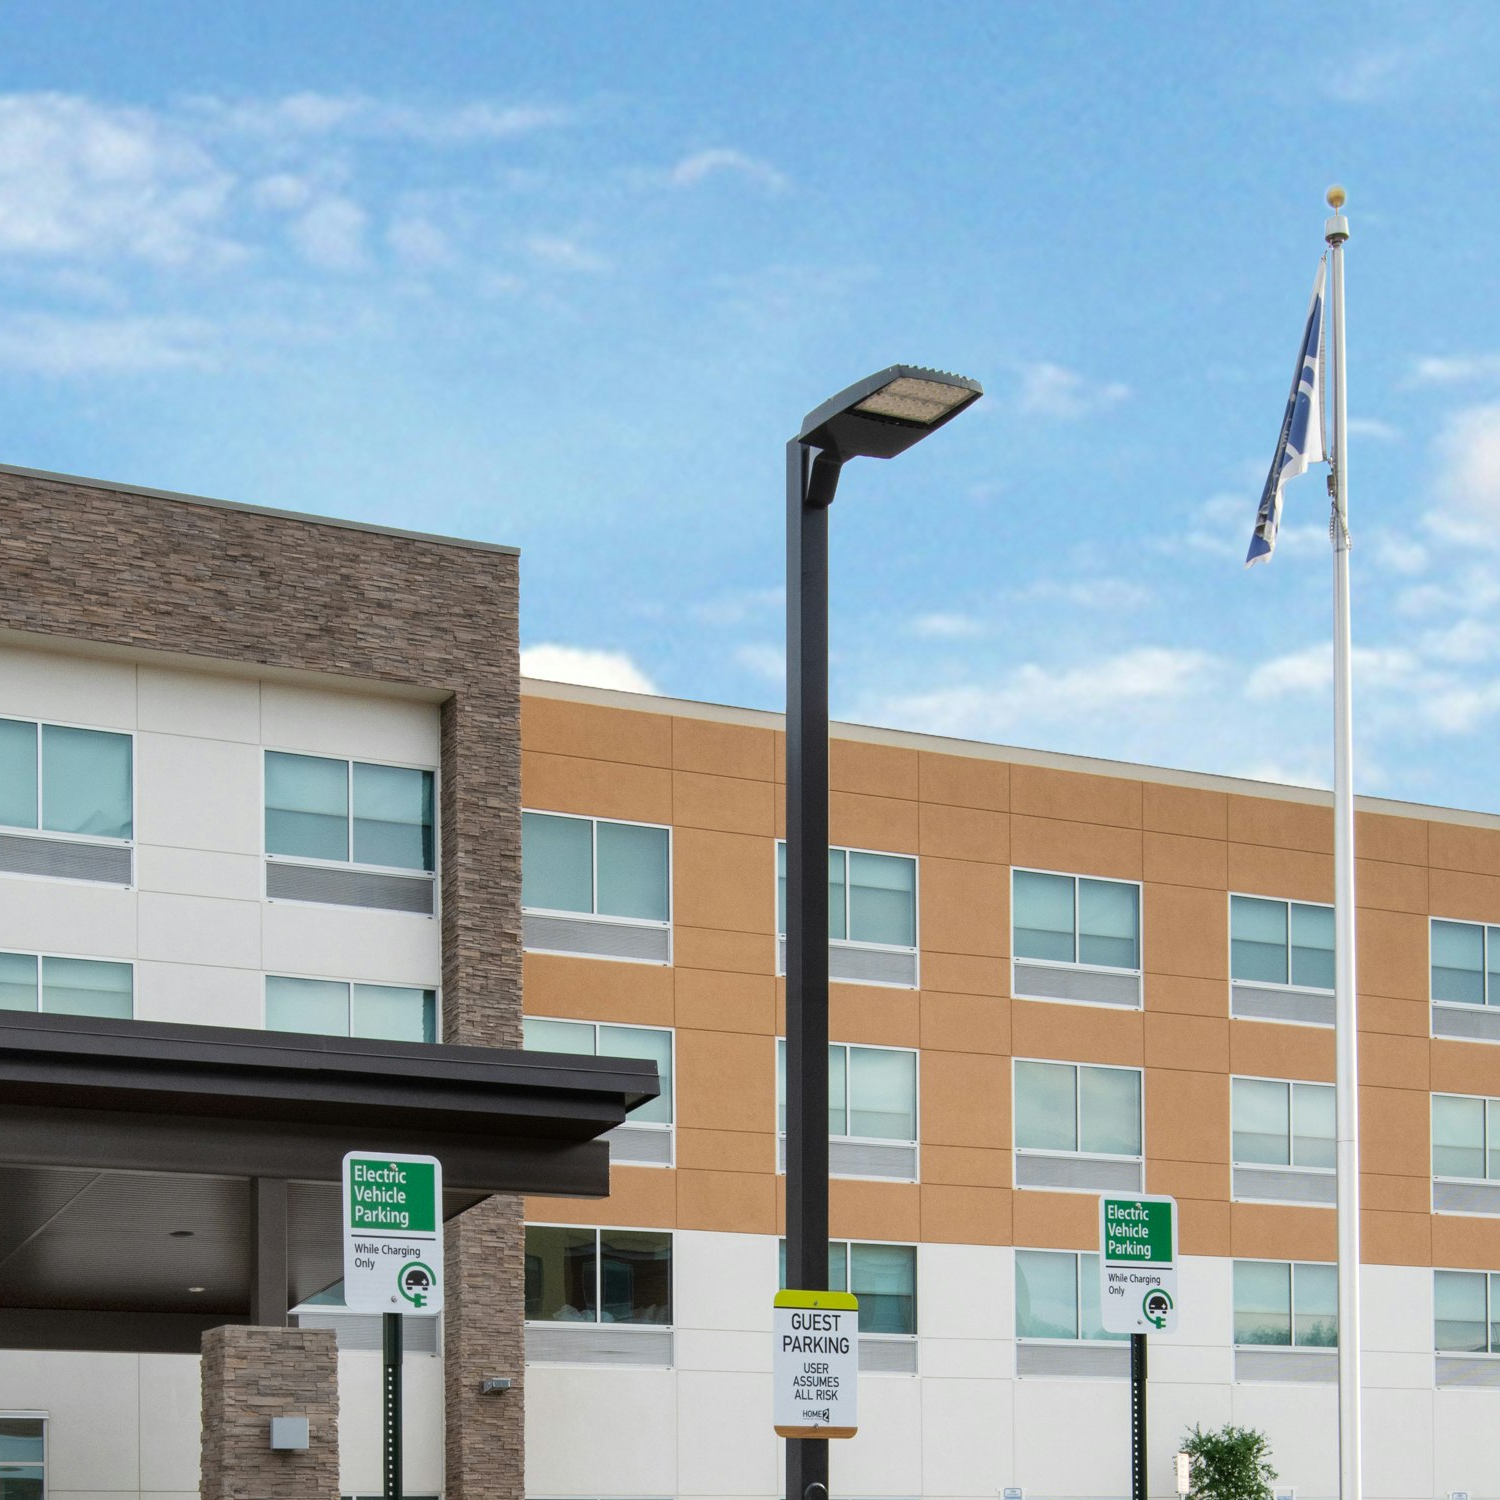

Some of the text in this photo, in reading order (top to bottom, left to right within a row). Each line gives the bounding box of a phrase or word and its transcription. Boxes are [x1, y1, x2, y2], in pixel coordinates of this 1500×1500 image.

[354, 1165, 407, 1184] Electric
[354, 1185, 406, 1204] Vehicle
[355, 1205, 409, 1228] Parking
[1107, 1204, 1149, 1221] Electric
[1107, 1222, 1149, 1239] Vehicle
[354, 1243, 421, 1259] While Charging
[1108, 1240, 1152, 1259] Parking
[354, 1257, 375, 1270] Only
[1108, 1273, 1161, 1286] While Charging
[1108, 1286, 1125, 1297] Only
[791, 1313, 841, 1332] GUEST
[782, 1335, 850, 1354] PARKING
[803, 1362, 829, 1374] USER
[792, 1376, 840, 1388] ASSUMES
[794, 1389, 839, 1401] ALL RISK
